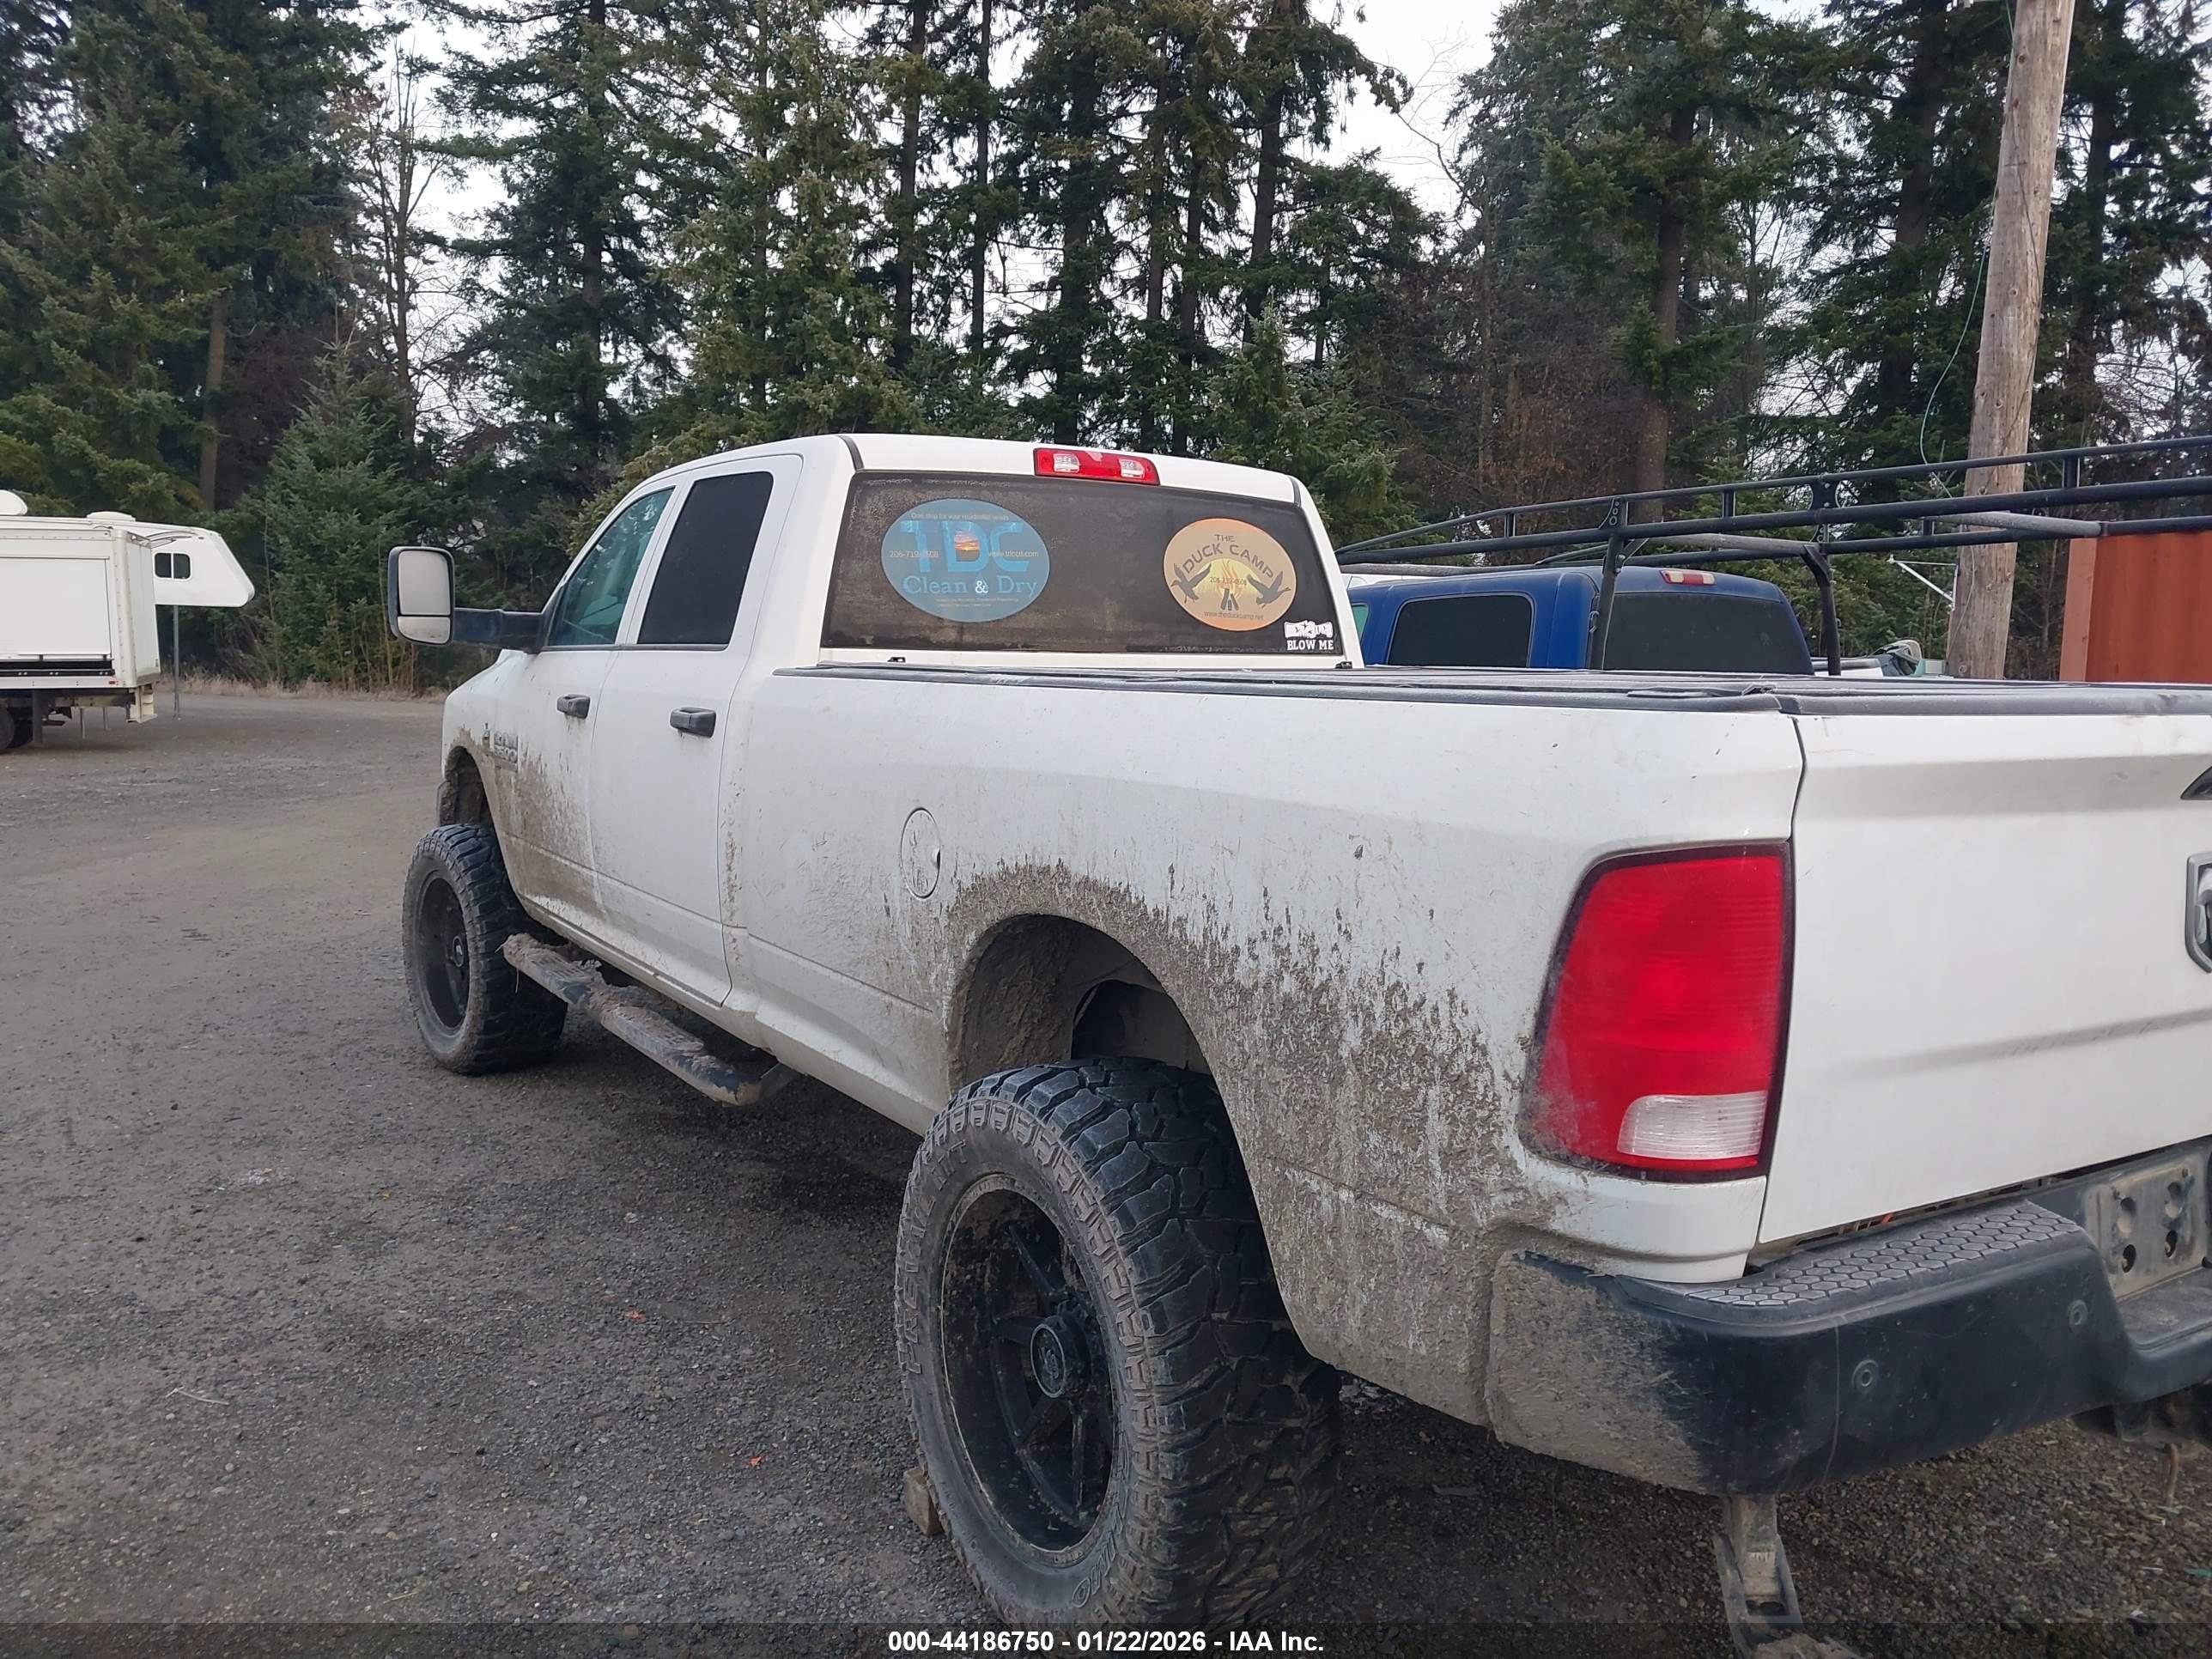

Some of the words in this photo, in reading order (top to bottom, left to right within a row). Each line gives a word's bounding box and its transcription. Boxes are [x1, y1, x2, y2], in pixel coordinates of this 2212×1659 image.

[1214, 534, 1237, 543] THE
[1182, 543, 1224, 574] DUCK
[1230, 544, 1273, 578] CAMP
[902, 574, 968, 594] Clean
[975, 580, 989, 594] &
[997, 574, 1038, 598] Dry
[1286, 639, 1316, 651] BLOW
[1318, 639, 1334, 651] ME
